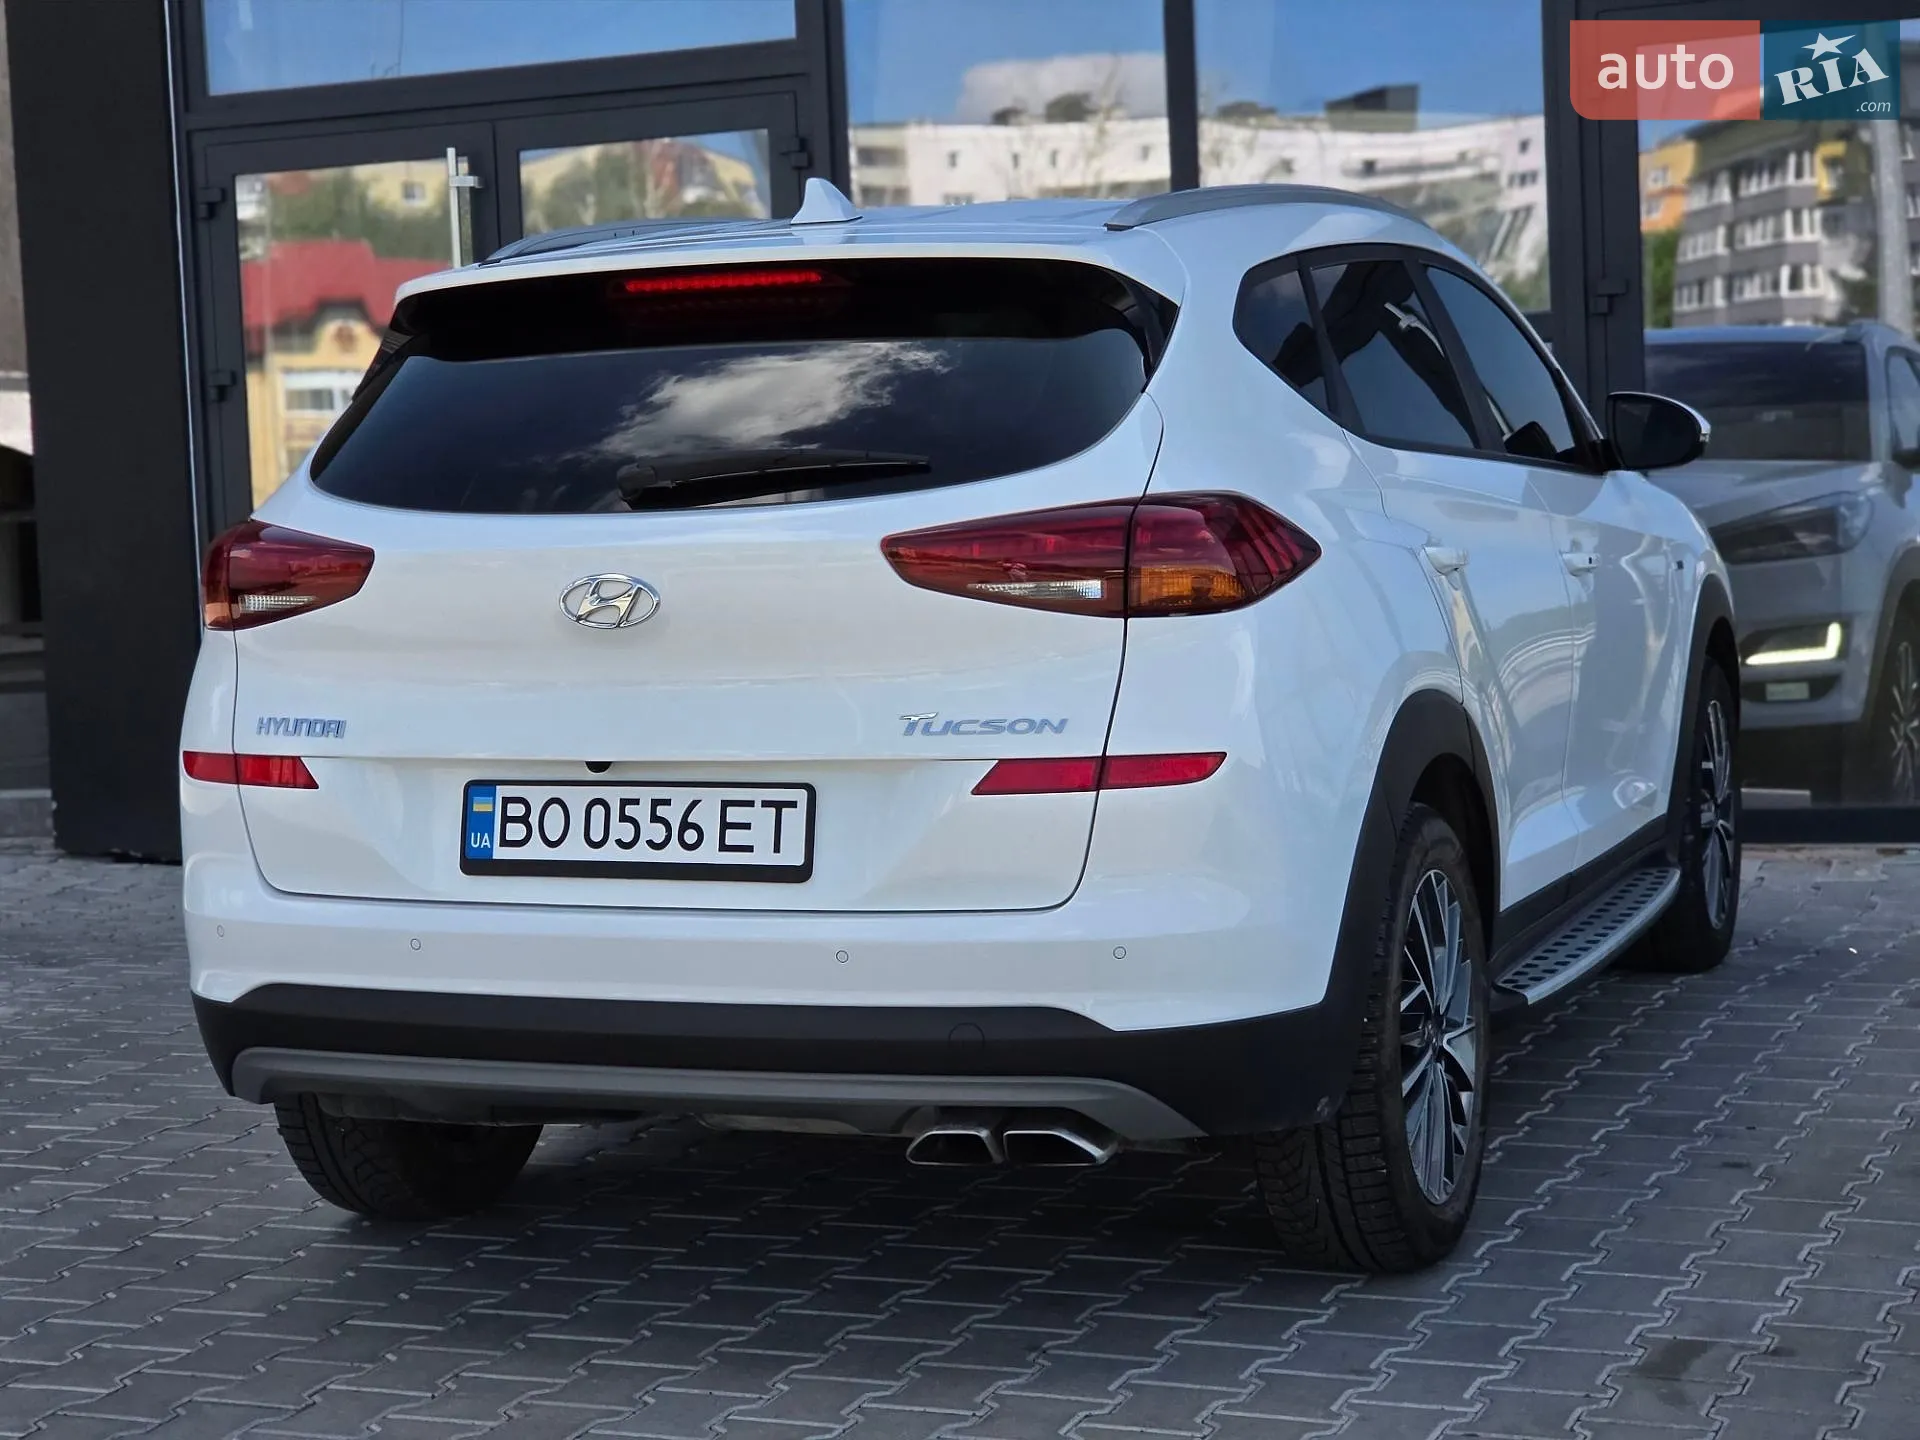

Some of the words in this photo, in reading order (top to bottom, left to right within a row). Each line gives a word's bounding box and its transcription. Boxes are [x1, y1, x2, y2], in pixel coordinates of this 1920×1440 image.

[256, 717, 347, 739] HYUNDAI
[498, 796, 571, 849] BO
[583, 797, 705, 852] 0556
[717, 799, 798, 854] ET
[470, 832, 491, 849] UA
